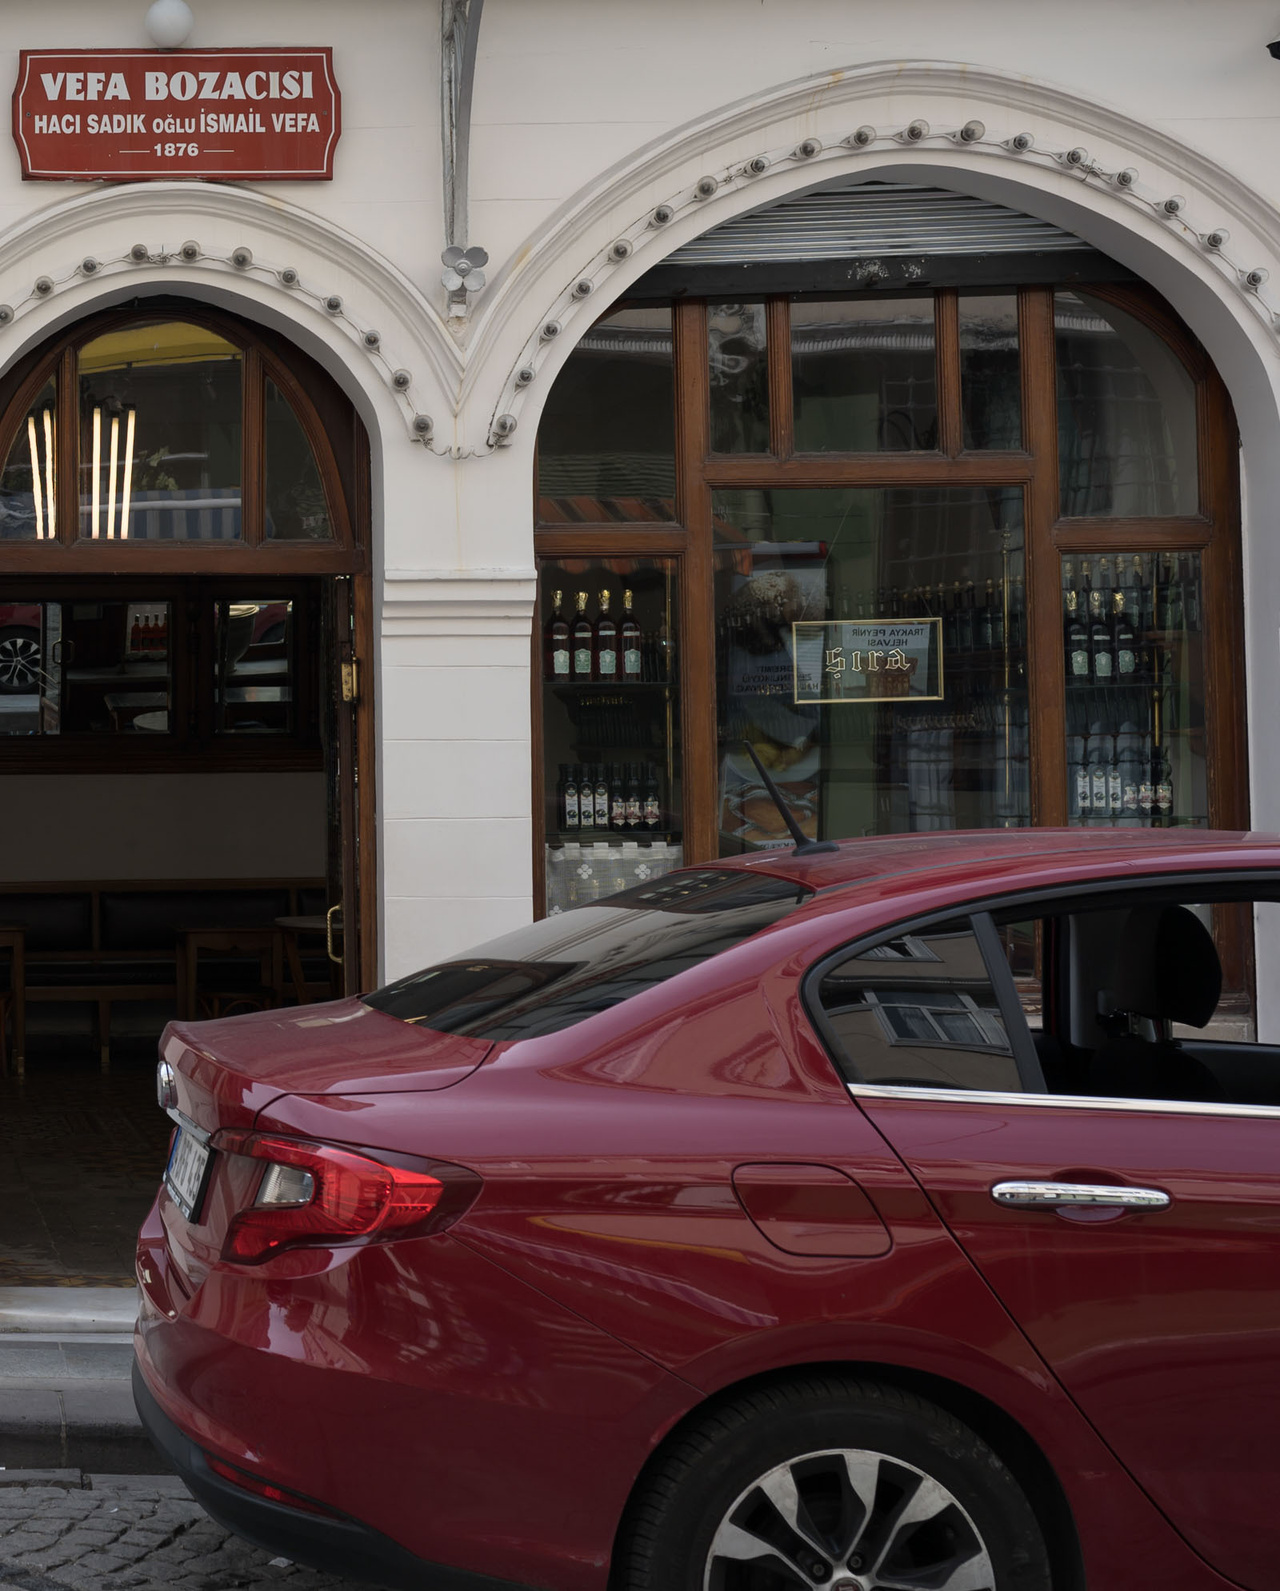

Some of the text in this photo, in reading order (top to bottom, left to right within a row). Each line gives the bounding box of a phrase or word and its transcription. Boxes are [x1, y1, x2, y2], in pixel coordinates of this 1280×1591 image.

[40, 71, 313, 101] VEFA BOZACISI
[34, 108, 320, 134] HACI SADIK OĞLU İSMAİL VEFA
[154, 143, 199, 157] 1876
[825, 647, 911, 679] Şıra
